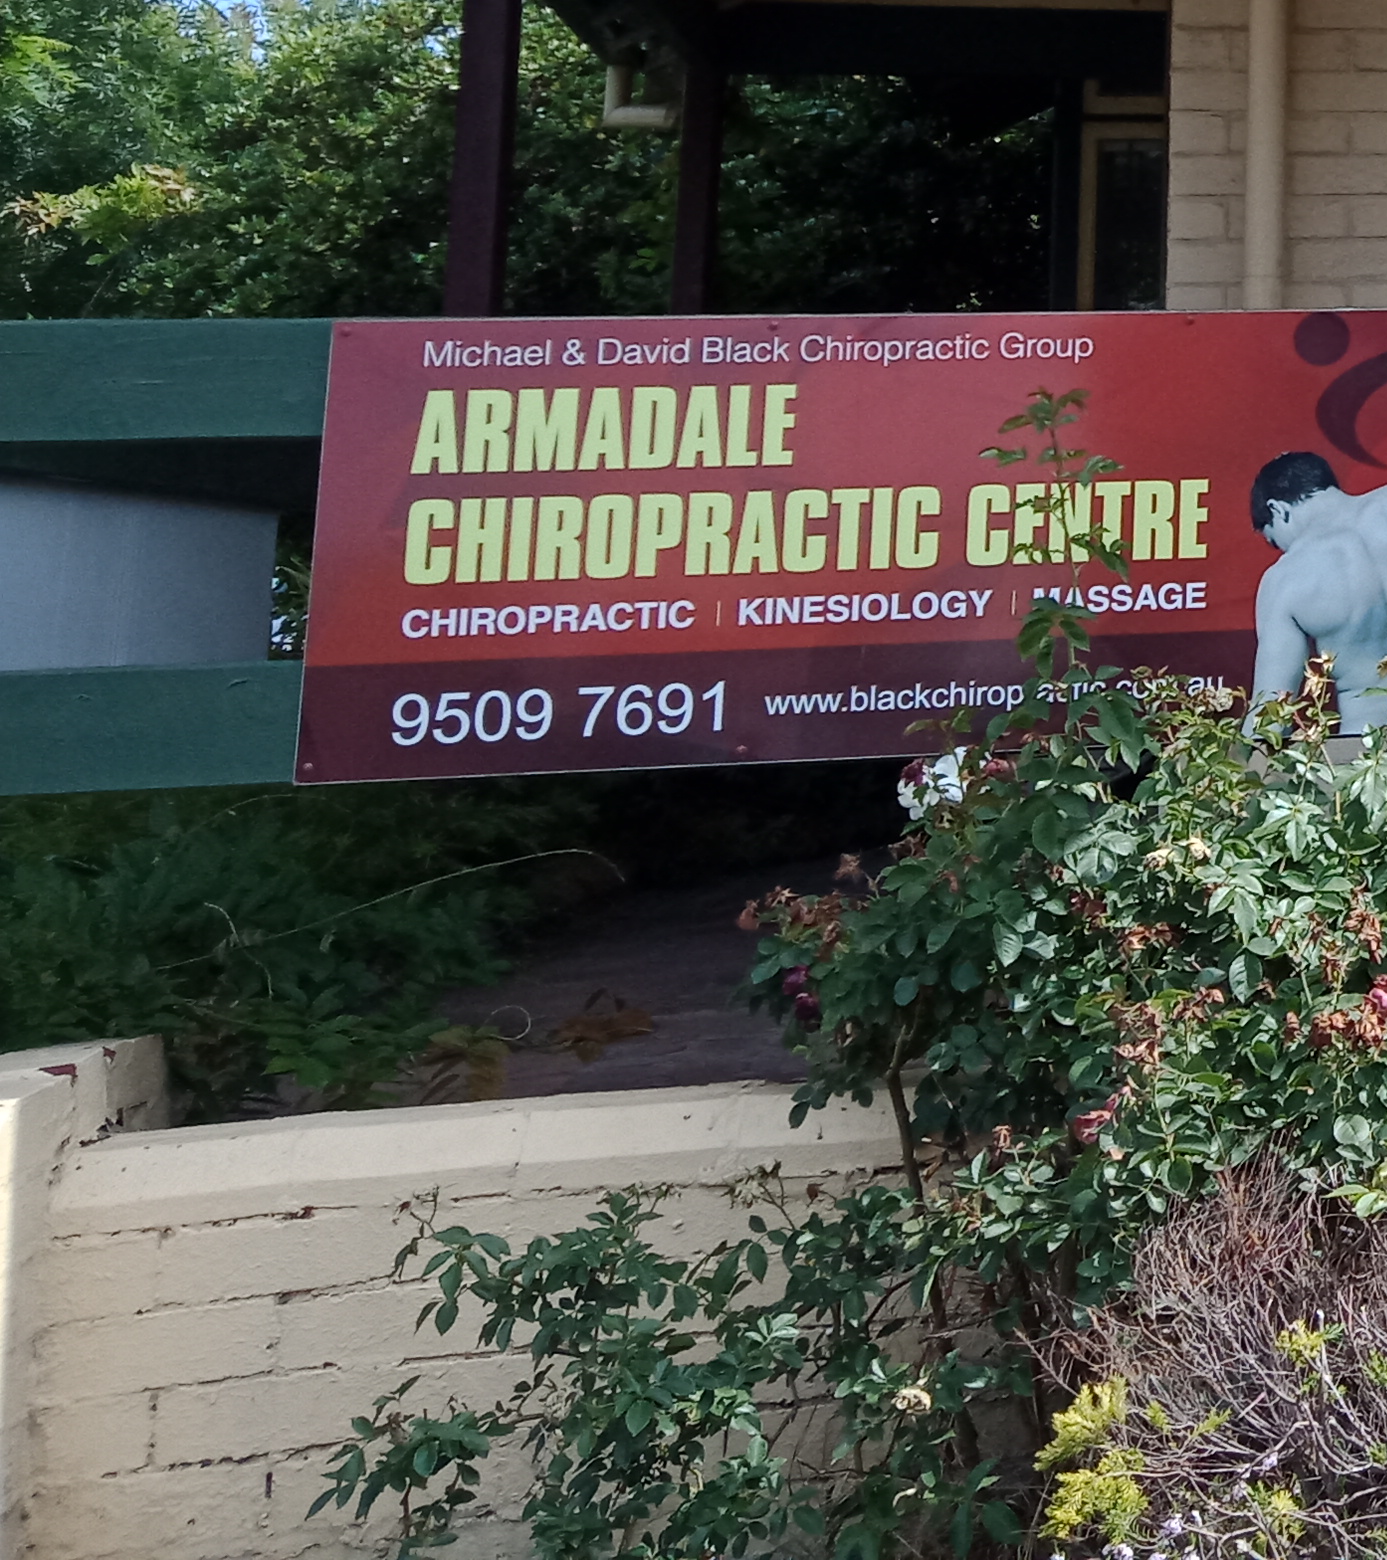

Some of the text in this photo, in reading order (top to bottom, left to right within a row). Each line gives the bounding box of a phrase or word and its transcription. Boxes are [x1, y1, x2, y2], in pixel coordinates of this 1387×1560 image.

[422, 331, 1095, 368] Michael & David Black Chiropractic Group
[409, 383, 799, 475] ARMADALE
[403, 478, 1210, 585] CHIROPRACTIC CENTRE
[401, 599, 697, 639] CHIROPRACTIC
[737, 589, 993, 626] KINESIOLOGY
[391, 680, 726, 747] 9509 7691
